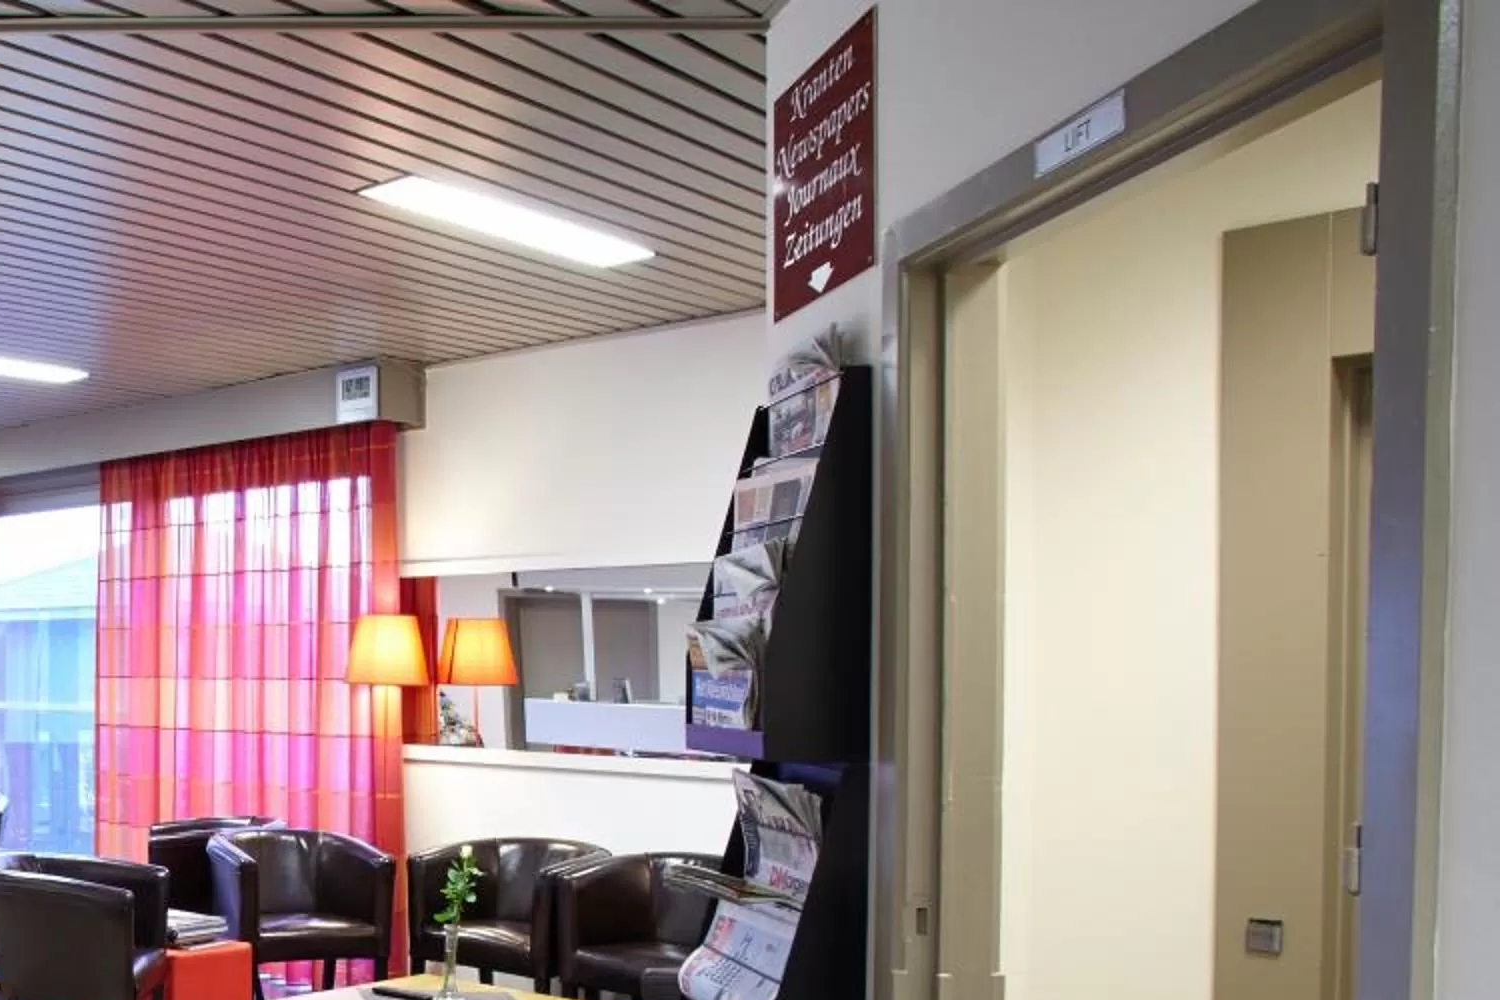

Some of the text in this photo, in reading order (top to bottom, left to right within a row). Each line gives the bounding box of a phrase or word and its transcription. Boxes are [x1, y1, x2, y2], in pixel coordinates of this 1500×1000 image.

[789, 44, 854, 121] Kranten
[775, 81, 871, 180] Newspapers
[1063, 118, 1092, 153] LIFT
[784, 143, 862, 227] Journaux
[783, 193, 863, 269] Zeitungen
